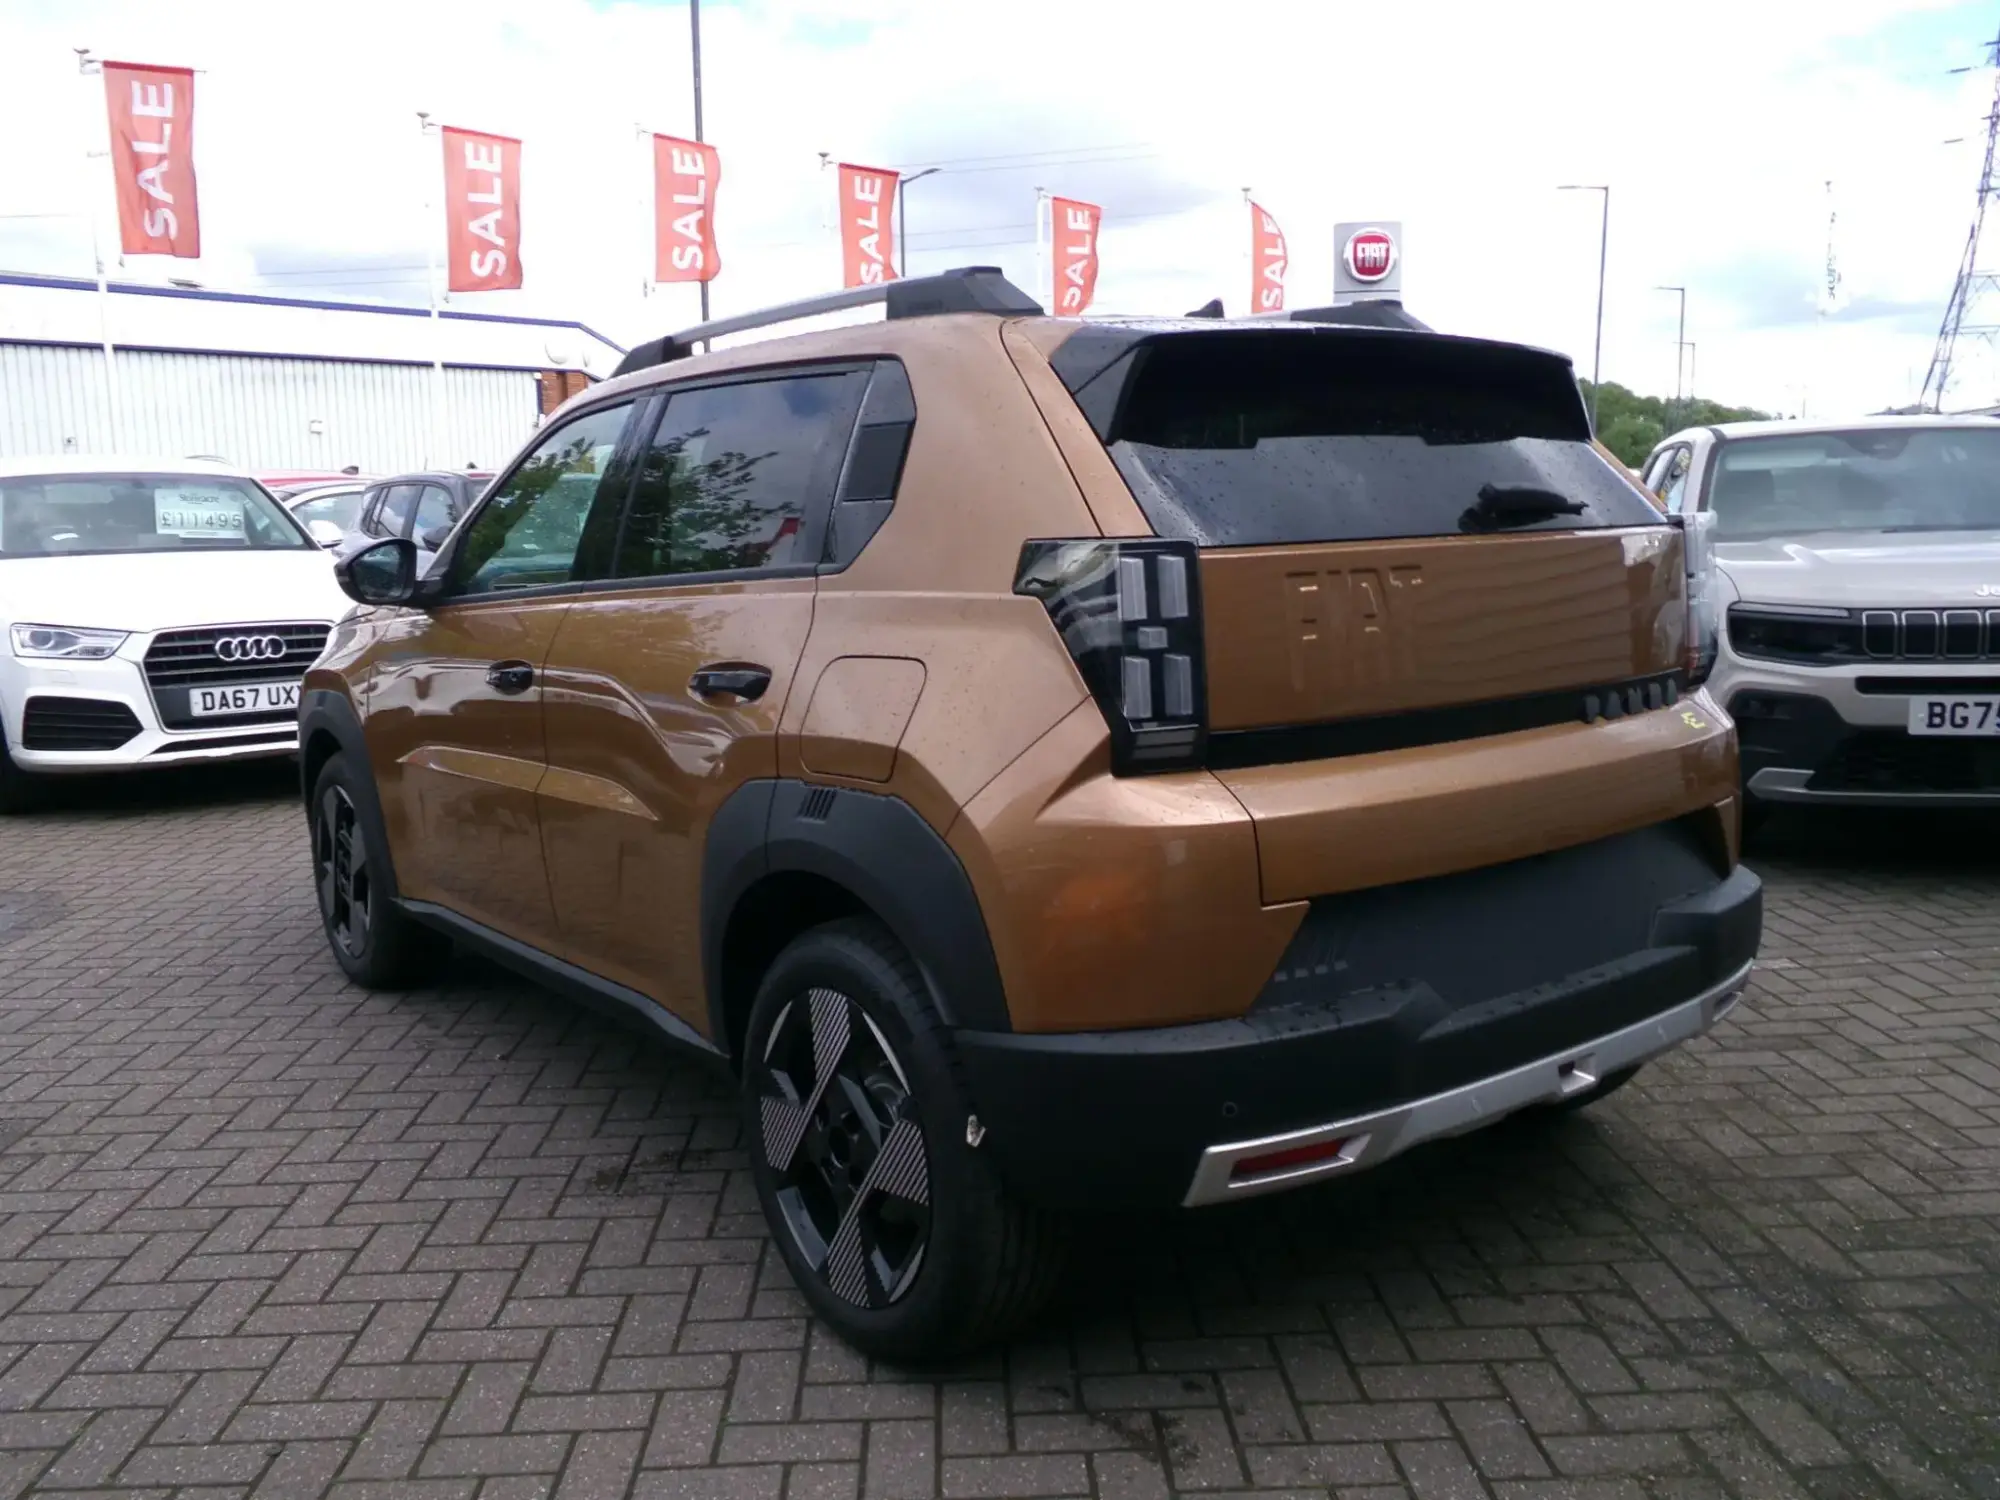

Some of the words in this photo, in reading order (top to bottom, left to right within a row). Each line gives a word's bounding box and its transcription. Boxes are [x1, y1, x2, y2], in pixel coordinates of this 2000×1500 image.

[131, 80, 179, 240] SALE
[463, 141, 508, 279] SALE
[671, 147, 706, 270] SALE
[854, 175, 885, 285] SALE
[1355, 242, 1389, 268] FIAT
[161, 511, 242, 528] £11495
[201, 689, 259, 711] DA67
[1926, 701, 2000, 729] BG7
